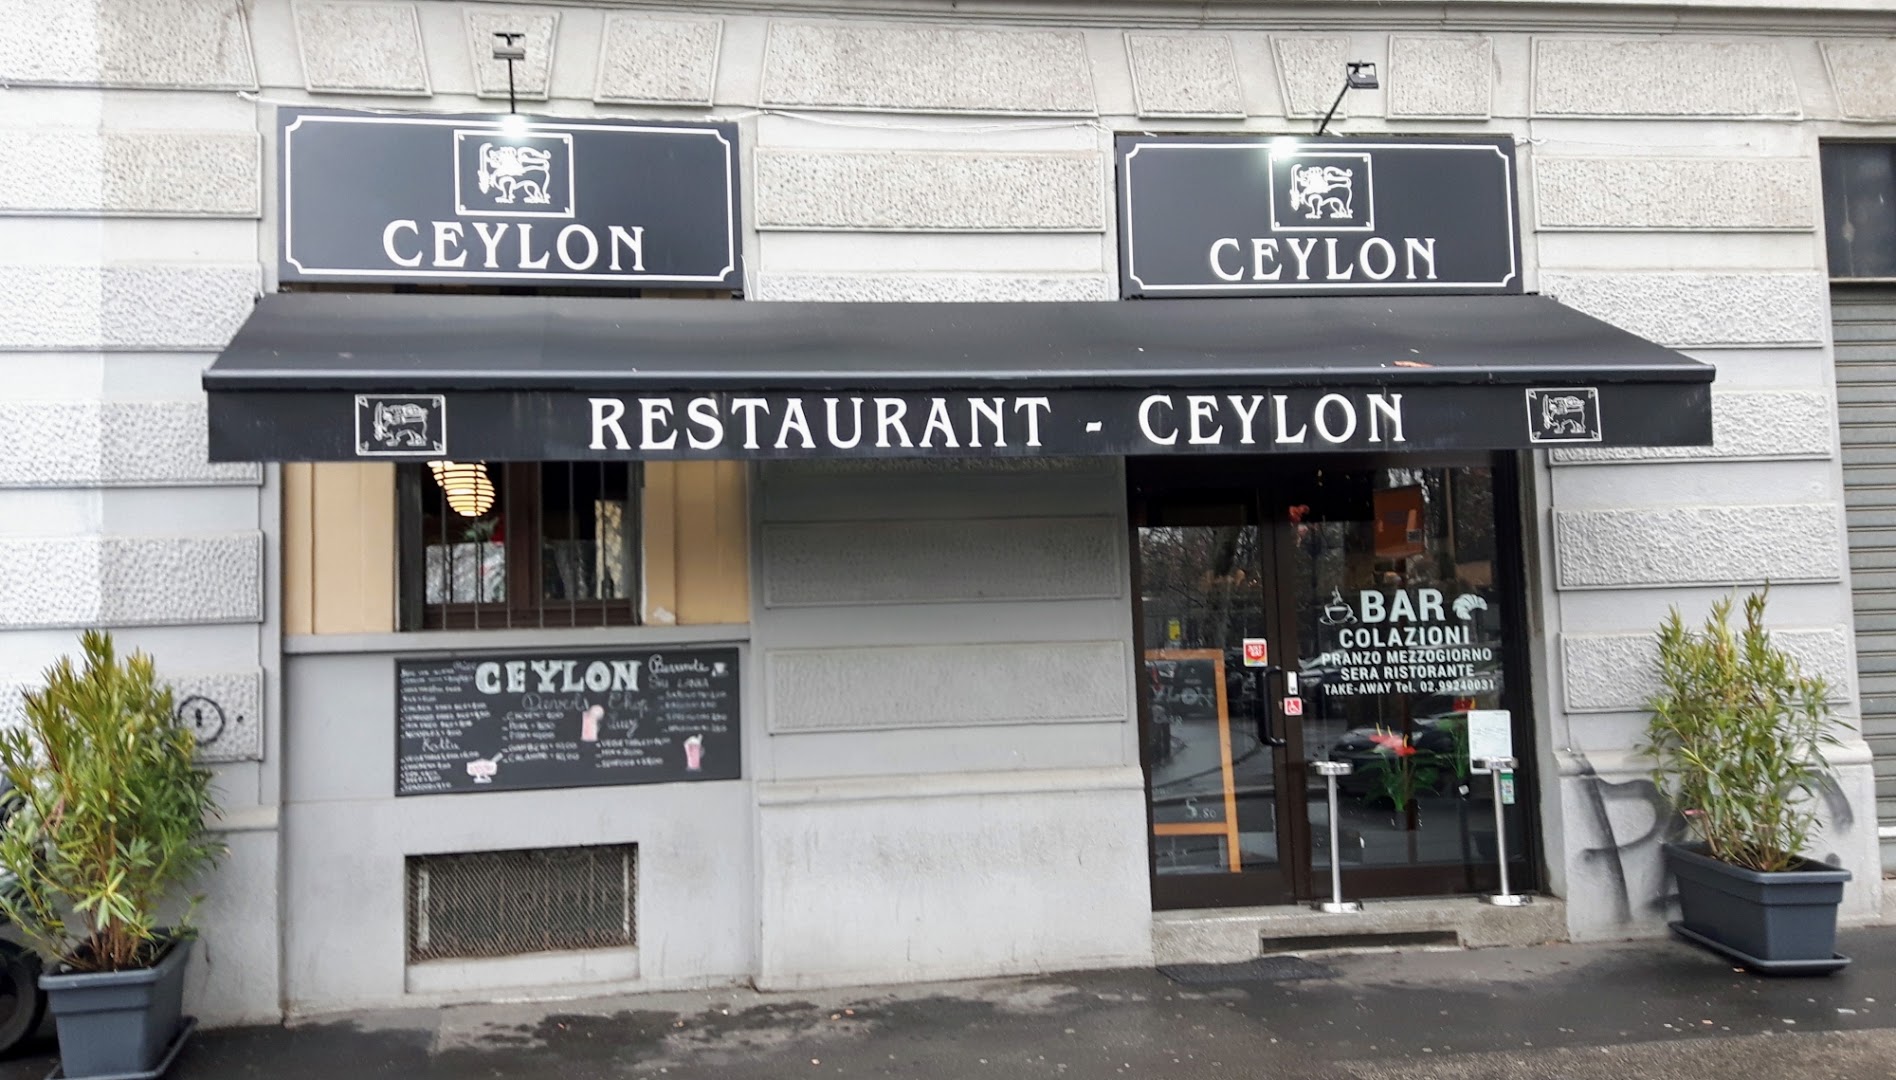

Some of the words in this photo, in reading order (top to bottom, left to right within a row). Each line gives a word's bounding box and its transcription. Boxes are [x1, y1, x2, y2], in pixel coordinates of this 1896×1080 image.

[382, 219, 646, 271] CEYLON
[1209, 236, 1438, 281] CEYLON
[588, 394, 1054, 451] RESTAURANT
[1137, 392, 1406, 446] CEYLON
[1360, 588, 1446, 623] BAR
[1339, 625, 1470, 648] COLAZIONI
[1321, 651, 1381, 666] PRANZO
[1387, 648, 1492, 664] MEZZOGIORNO
[1341, 667, 1379, 681] SERA
[1384, 664, 1474, 679] RISTORANTE
[475, 659, 641, 694] CEYLON
[1324, 682, 1392, 695] TAKE-AWAY
[1396, 681, 1416, 693] Tel.
